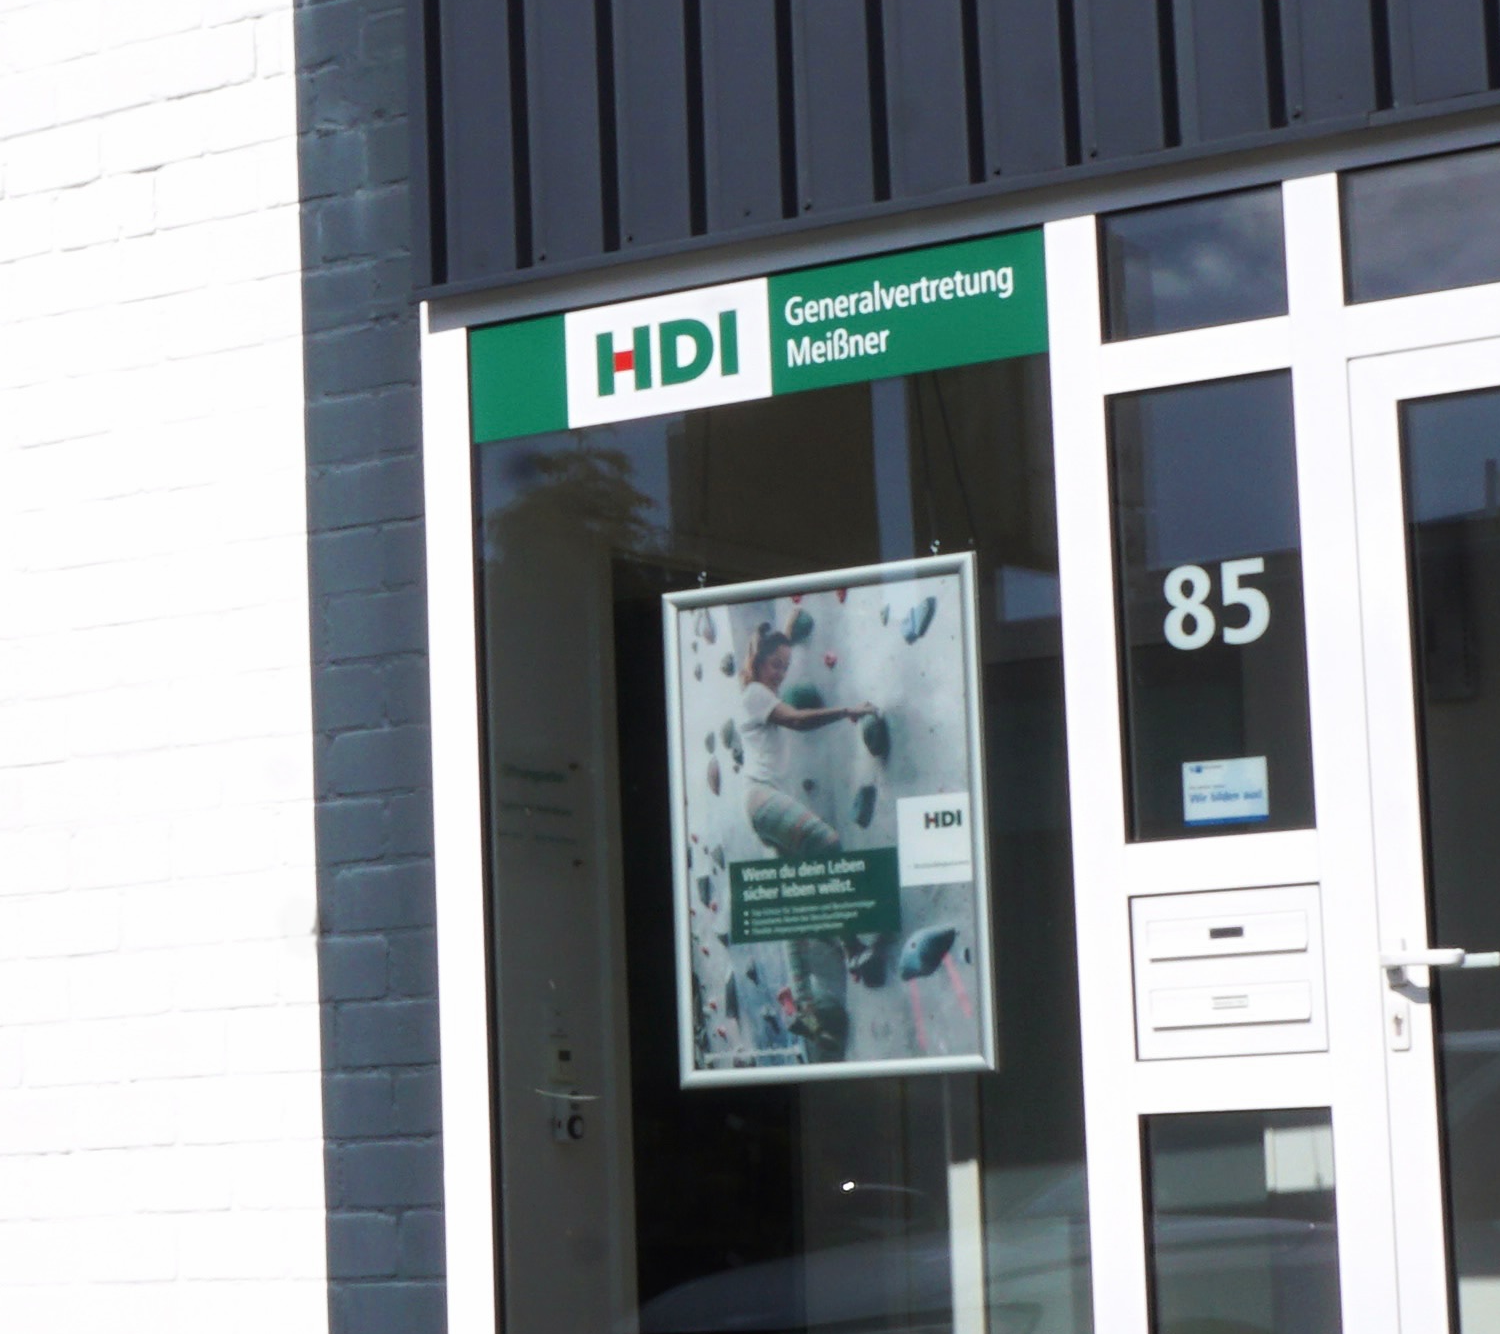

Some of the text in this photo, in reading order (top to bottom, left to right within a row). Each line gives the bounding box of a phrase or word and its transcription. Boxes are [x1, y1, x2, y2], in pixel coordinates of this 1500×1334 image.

[597, 264, 1014, 396] HDI Generalvertretung
[786, 326, 890, 368] Meißner
[1163, 557, 1271, 650] 85
[923, 809, 962, 829] HDI
[741, 858, 866, 882] Wenn du dein Leben
